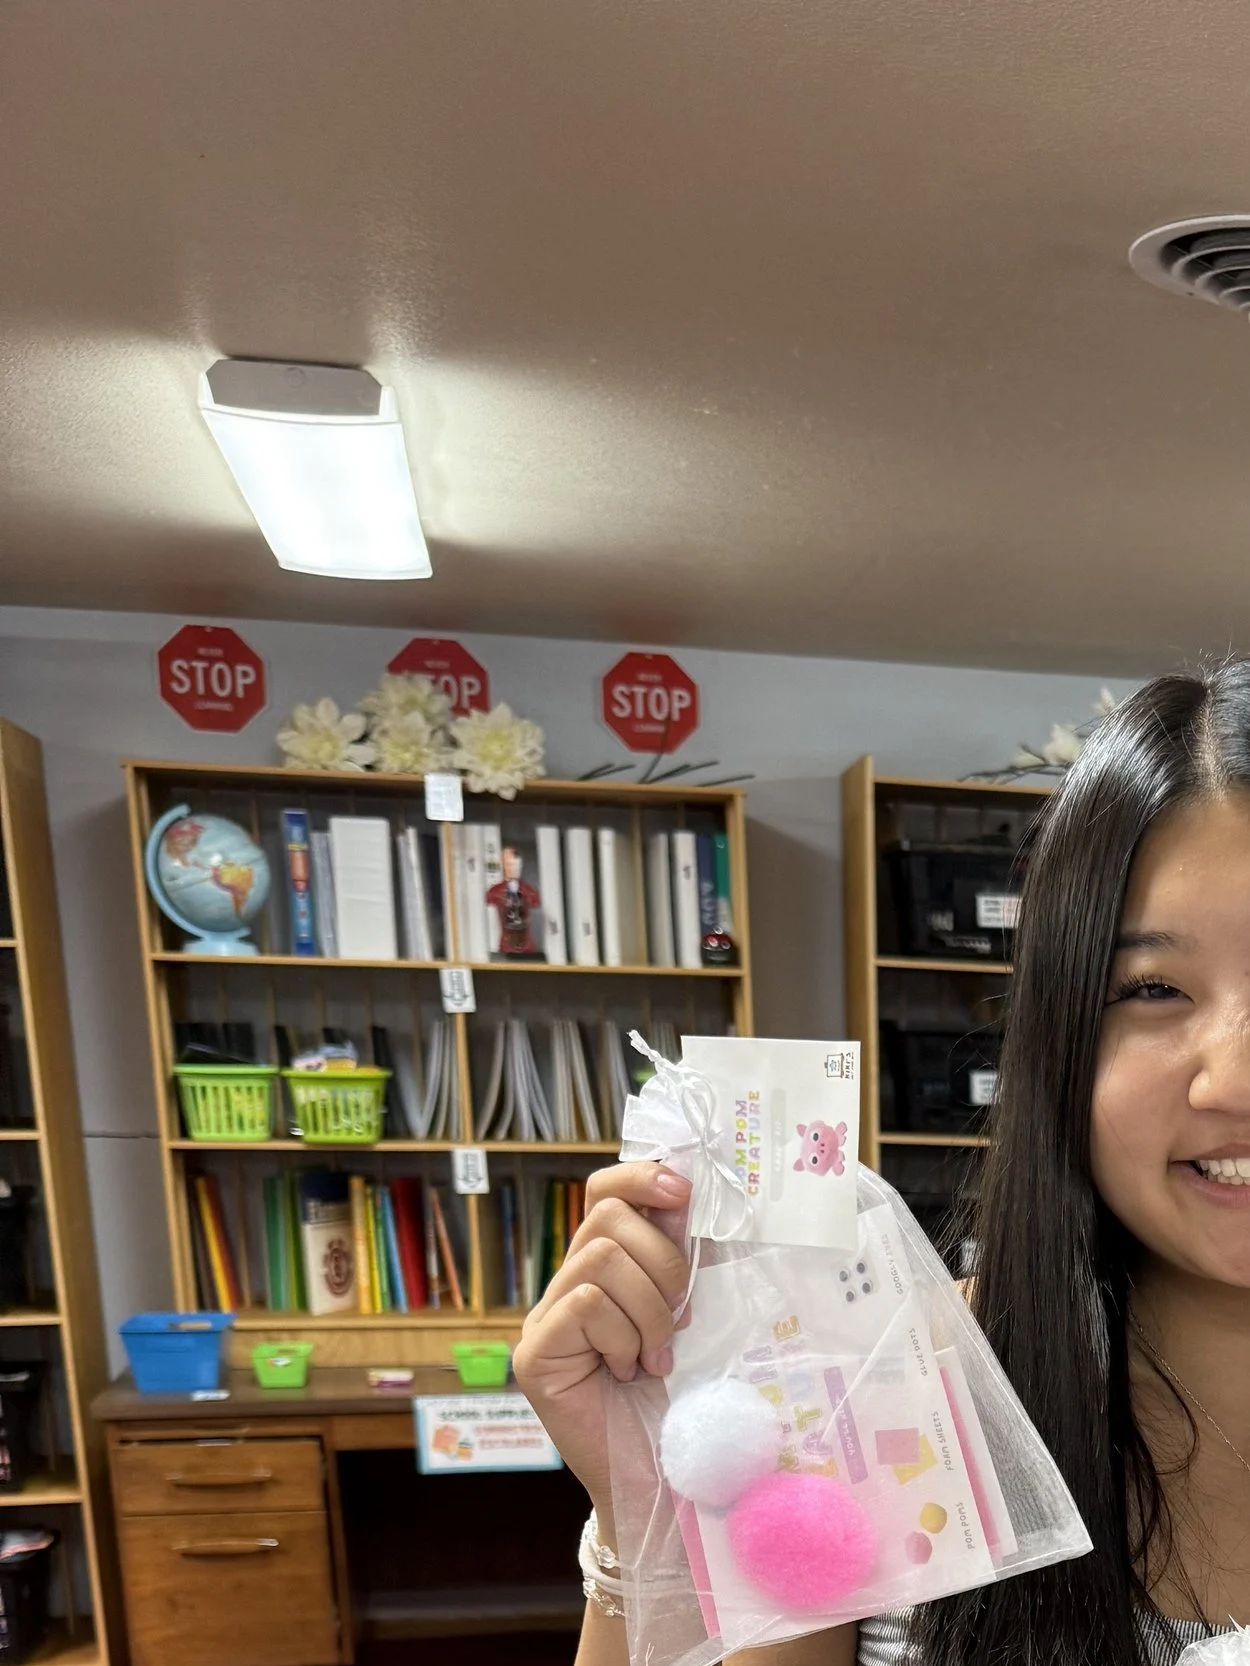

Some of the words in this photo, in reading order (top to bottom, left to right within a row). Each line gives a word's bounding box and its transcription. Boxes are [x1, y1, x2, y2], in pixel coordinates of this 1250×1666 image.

[170, 659, 256, 698] STOP
[611, 683, 692, 722] STOP
[748, 1090, 761, 1197] CREATURE
[908, 1328, 920, 1354] DOTS
[916, 1354, 928, 1377] GLUE
[931, 1411, 946, 1444] SHEETS
[942, 1446, 955, 1472] FOAM
[956, 1502, 968, 1528] POMS
[964, 1529, 976, 1550] POM
